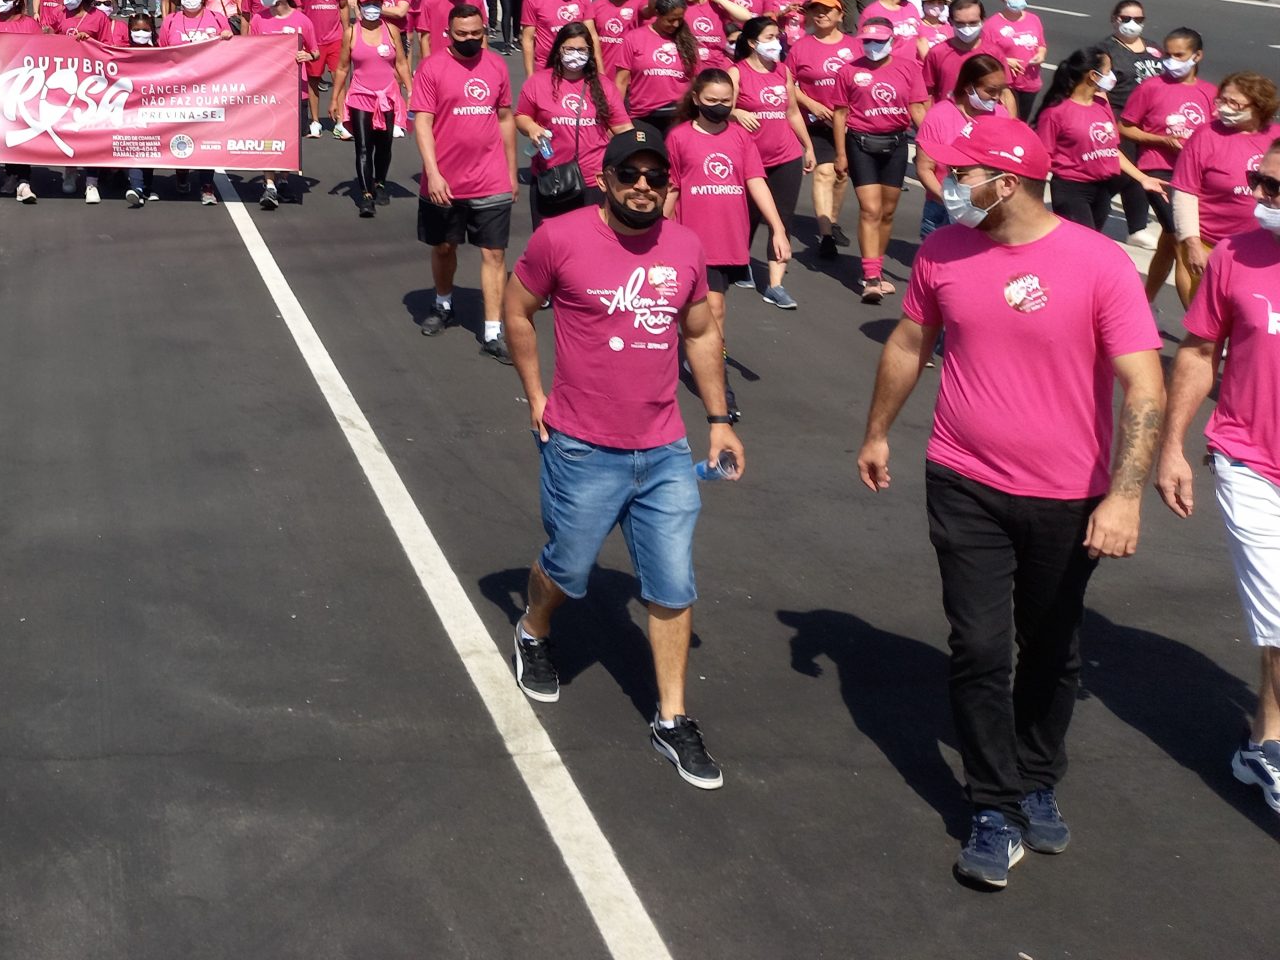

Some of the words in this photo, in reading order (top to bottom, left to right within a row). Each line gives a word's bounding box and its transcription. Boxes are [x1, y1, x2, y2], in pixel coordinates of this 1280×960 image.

[23, 56, 118, 76] OUTUBRO
[141, 83, 188, 95] CÂNCER
[192, 84, 207, 94] DE
[211, 83, 247, 94] MAMA
[141, 96, 166, 106] NÃO
[170, 96, 191, 106] FAZ
[196, 95, 281, 105] QUARENTENA.
[227, 139, 285, 151] BARUERI
[633, 308, 674, 335] Rosa
